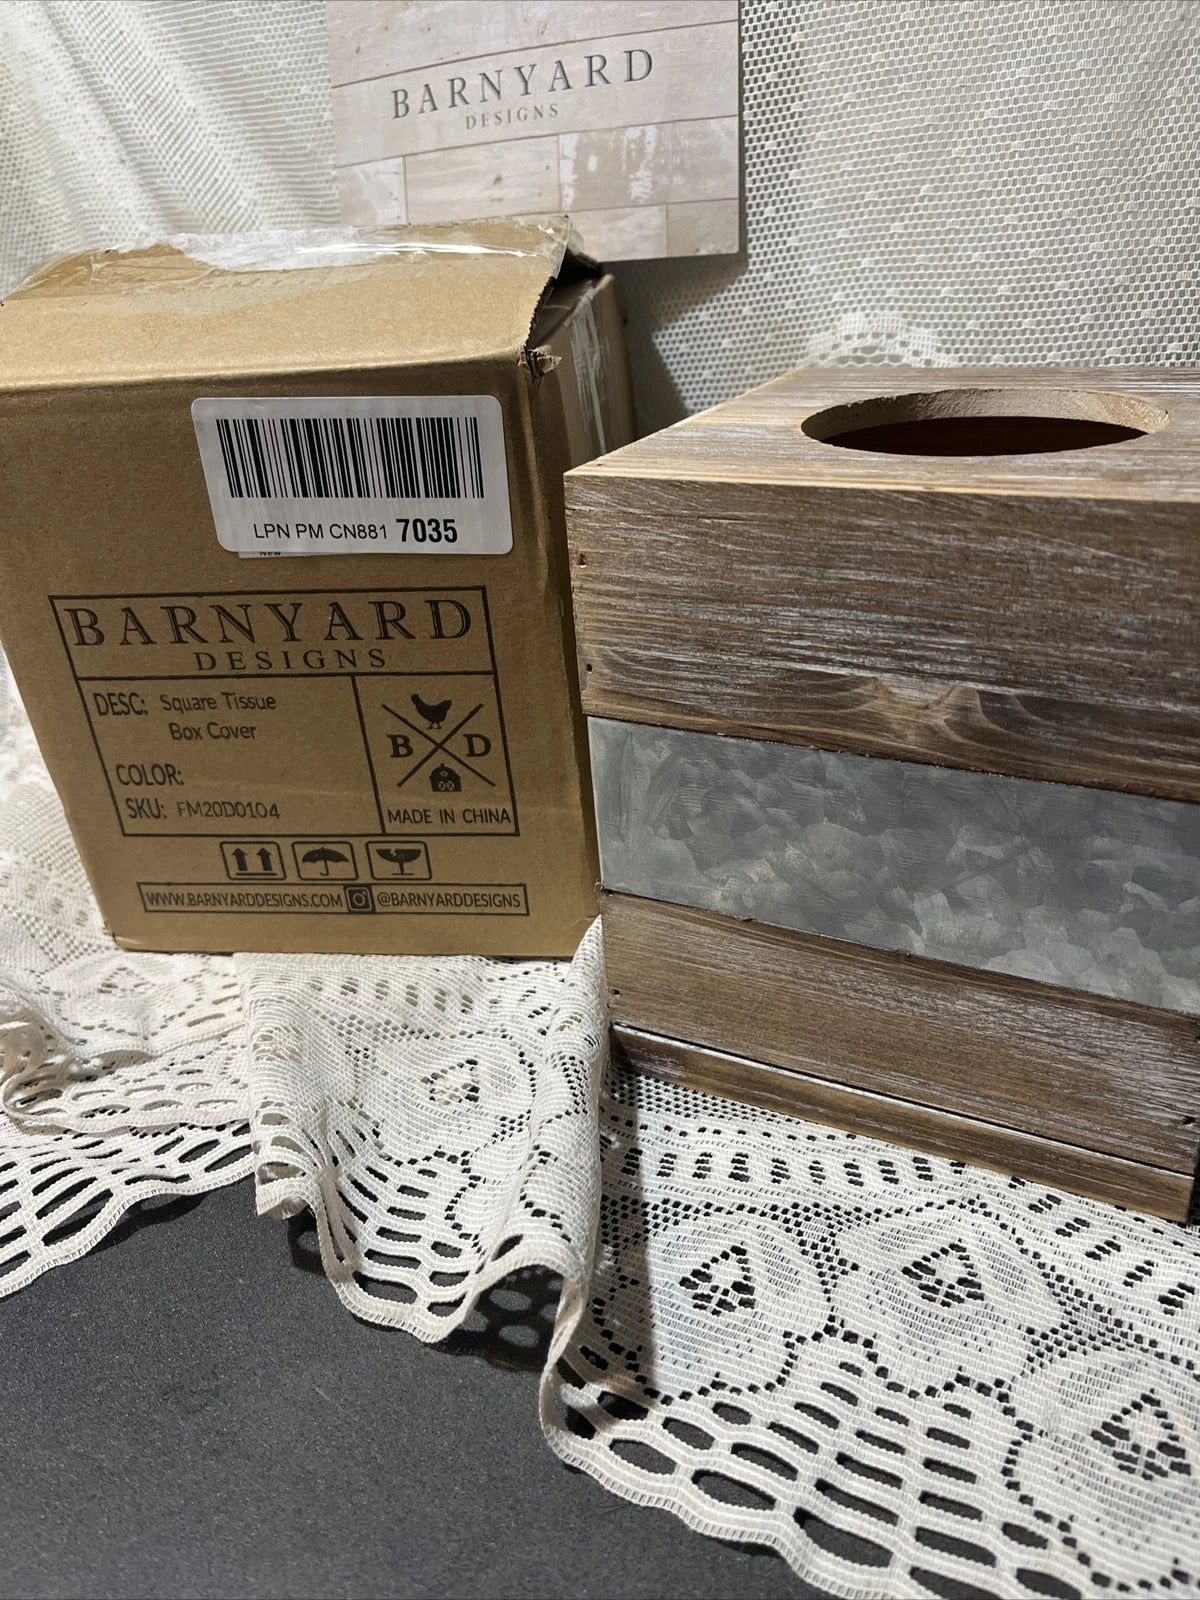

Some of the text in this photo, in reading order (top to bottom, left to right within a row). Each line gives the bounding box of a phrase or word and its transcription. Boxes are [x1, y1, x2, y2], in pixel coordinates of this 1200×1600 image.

[391, 48, 654, 120] BARNYARD
[465, 103, 560, 131] DESIGNS
[253, 518, 458, 543] LPN PM CN881 7035
[64, 599, 472, 646] BARNYARD
[195, 648, 387, 671] DESIGNS
[93, 692, 277, 716] DESC: Square Tissue
[168, 722, 257, 740] Box Cover
[387, 733, 492, 758] B D
[116, 764, 185, 786] COLOR:
[127, 799, 281, 820] SKU: FM20D0104
[387, 807, 511, 824] MADE IN CHINA
[145, 891, 343, 908] WWW.BARNYARDDESIGNS.COM
[377, 890, 521, 909] @BARNYARDDESIGNS
